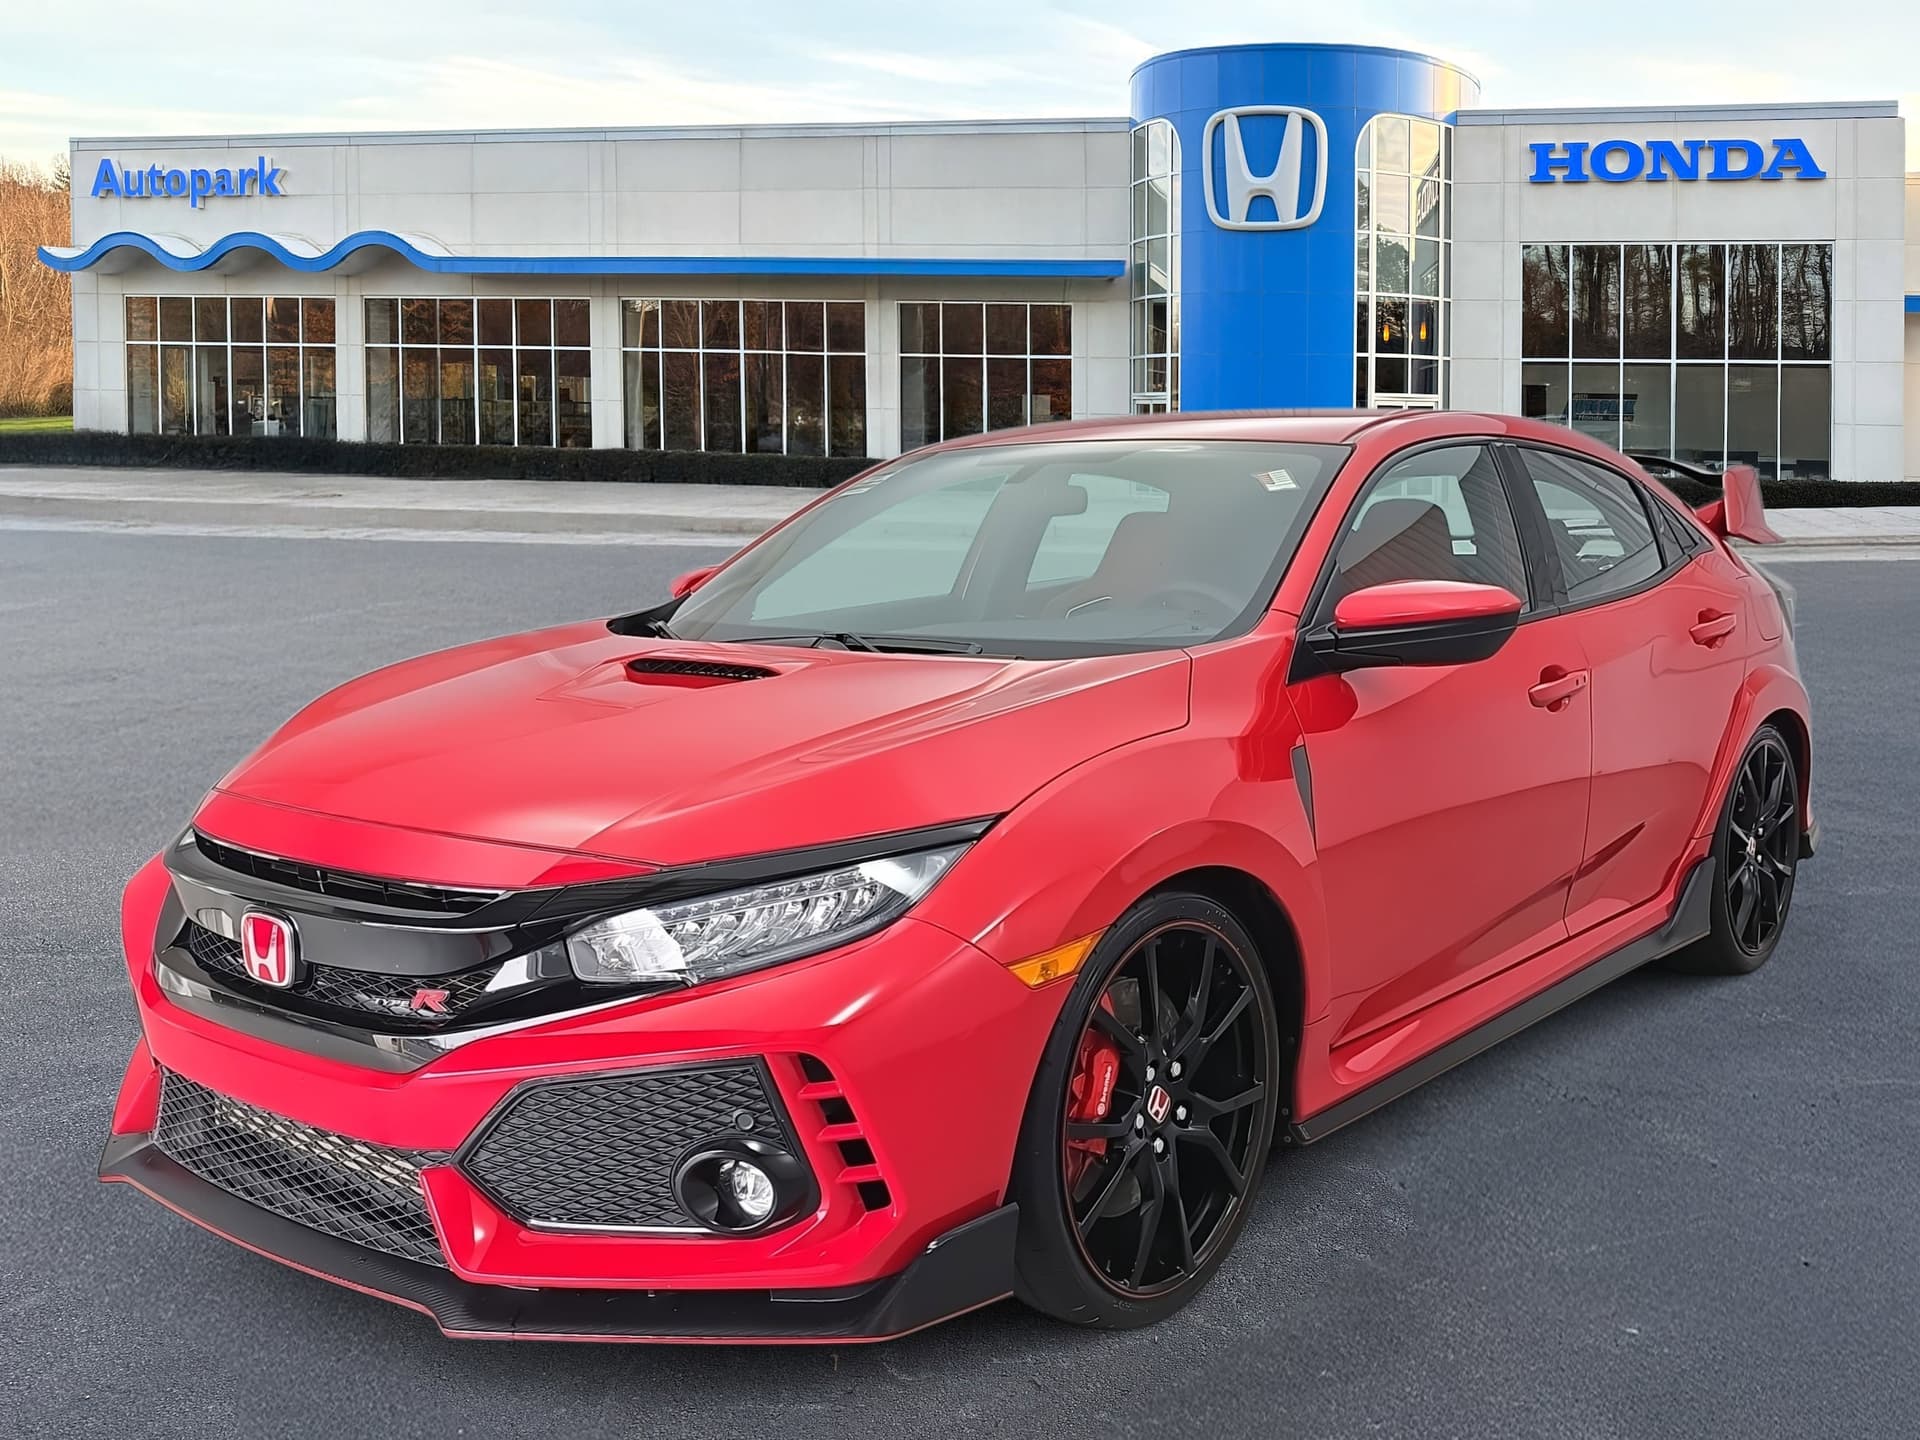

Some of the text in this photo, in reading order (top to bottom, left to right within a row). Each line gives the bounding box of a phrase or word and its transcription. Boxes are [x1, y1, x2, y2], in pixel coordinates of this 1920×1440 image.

[1528, 138, 1827, 183] HONDA
[90, 155, 283, 208] Autopark
[410, 988, 453, 1013] R
[1100, 1065, 1112, 1103] brembo
